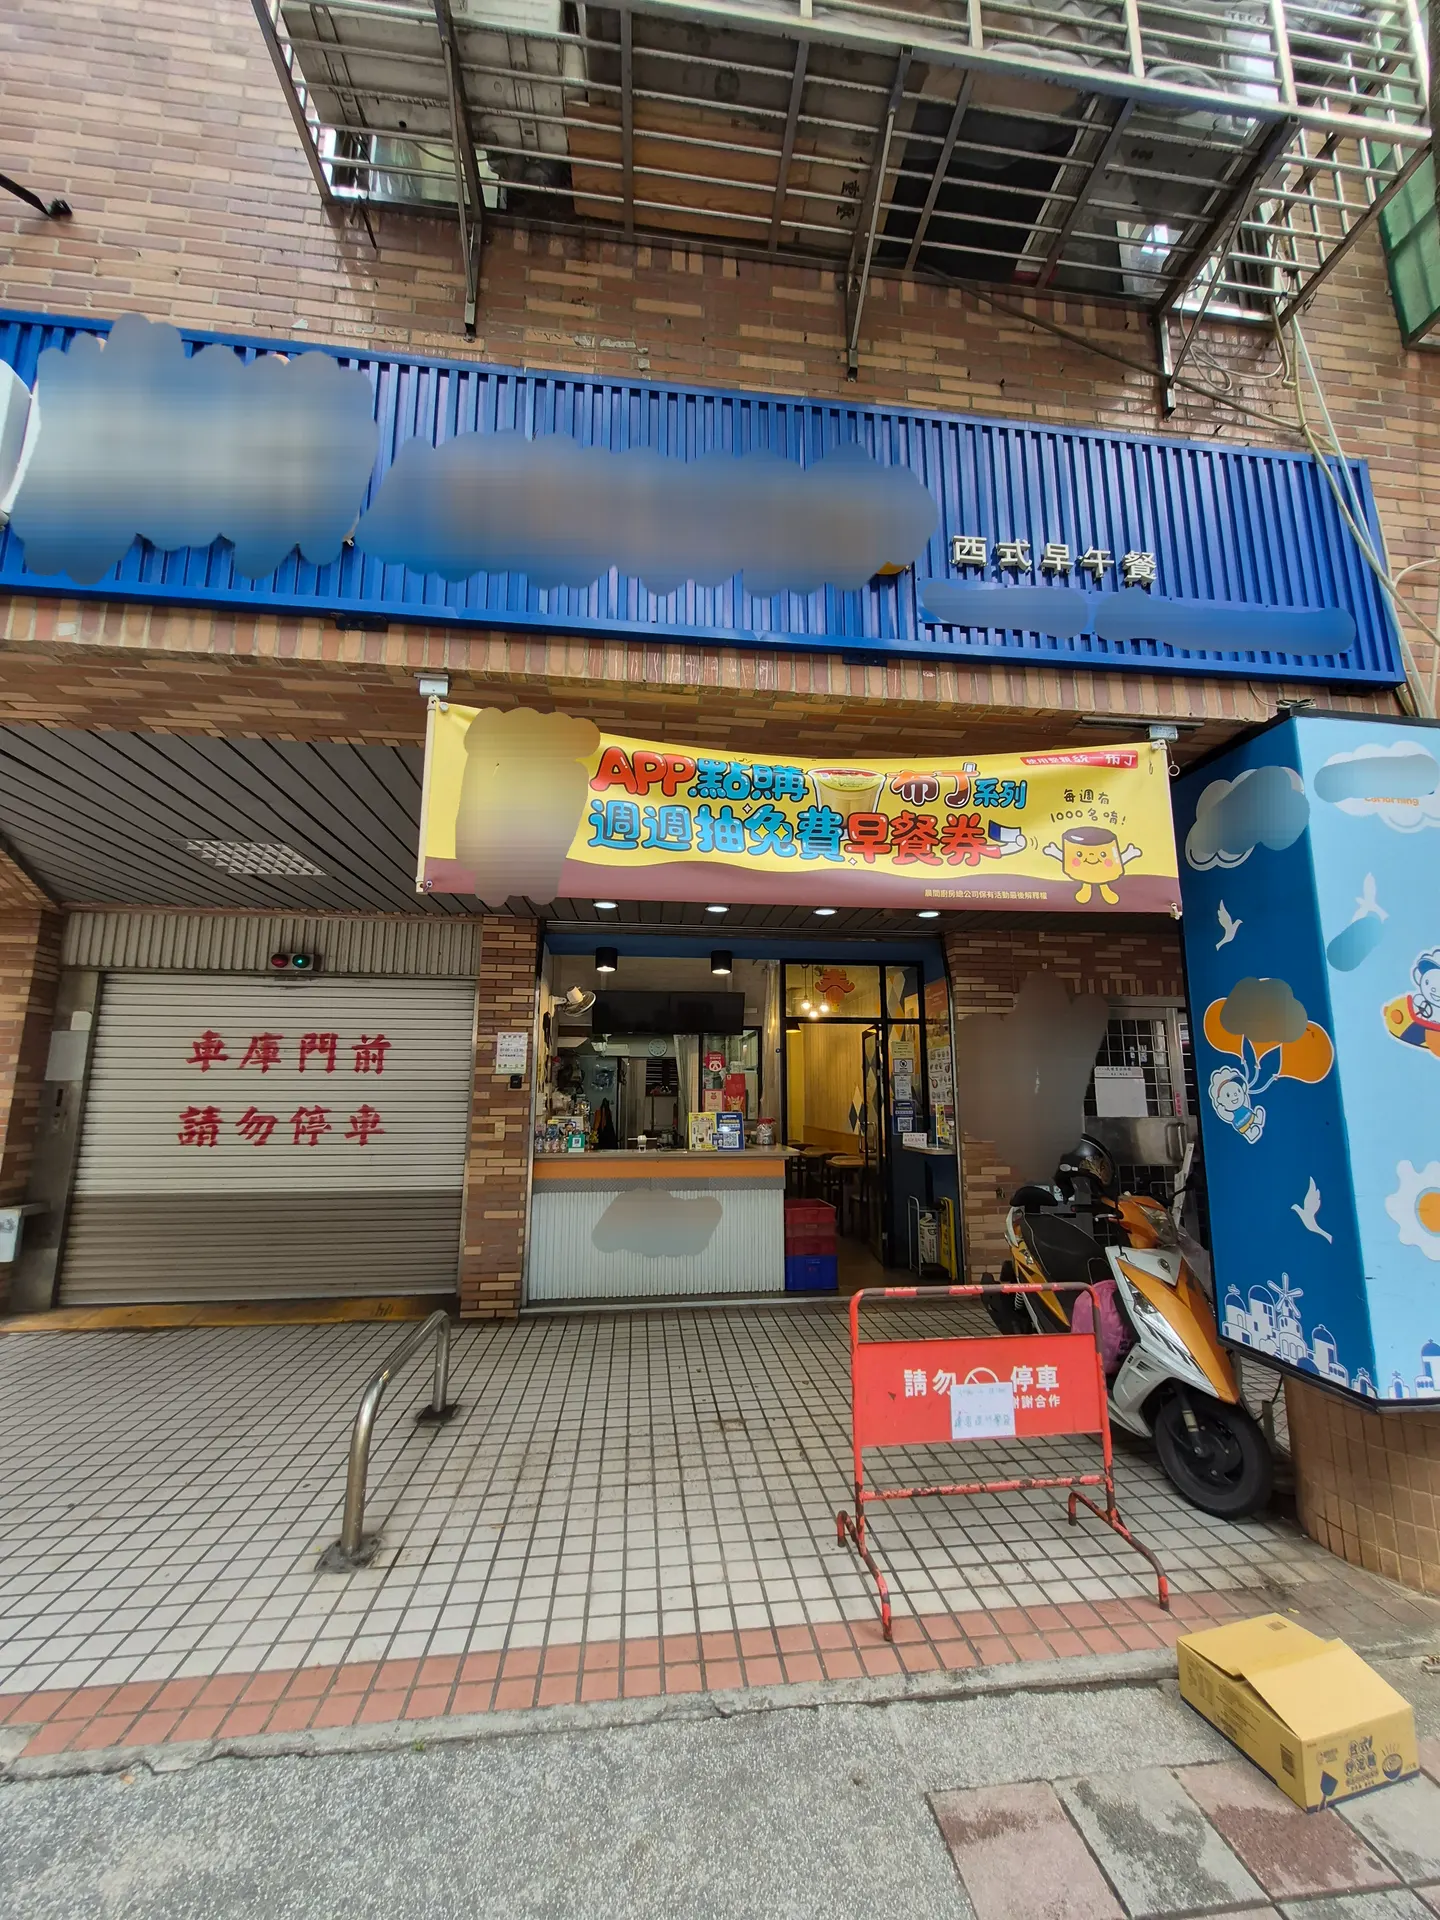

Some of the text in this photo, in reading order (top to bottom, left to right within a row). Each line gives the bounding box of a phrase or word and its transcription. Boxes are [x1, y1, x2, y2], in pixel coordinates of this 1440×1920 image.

[949, 535, 1157, 587] 西式早午餐
[589, 746, 1028, 810] APP點購 布丁系列
[1063, 789, 1110, 805] 每週有
[587, 798, 1002, 867] 週週抽免費早餐券
[186, 1030, 392, 1074] 車庫門前
[177, 1104, 386, 1147] 請勿停車
[904, 1365, 1060, 1398] 請勿 停車
